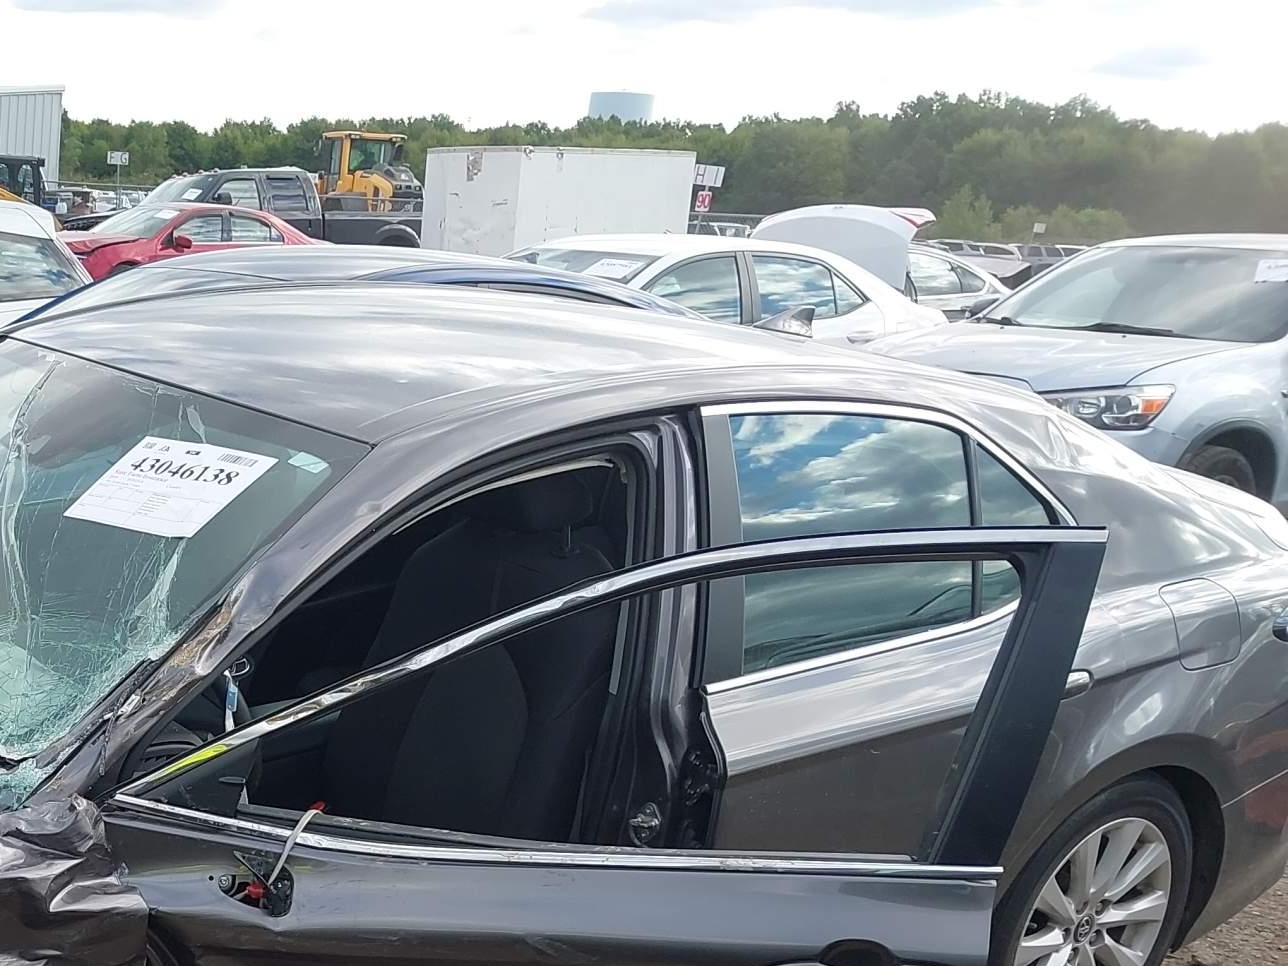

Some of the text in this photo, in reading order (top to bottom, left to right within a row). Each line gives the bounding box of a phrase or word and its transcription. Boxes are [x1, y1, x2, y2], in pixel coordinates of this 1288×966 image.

[120, 152, 128, 164] G
[695, 165, 707, 184] H
[696, 193, 711, 209] 90
[130, 456, 240, 486] 43046138
